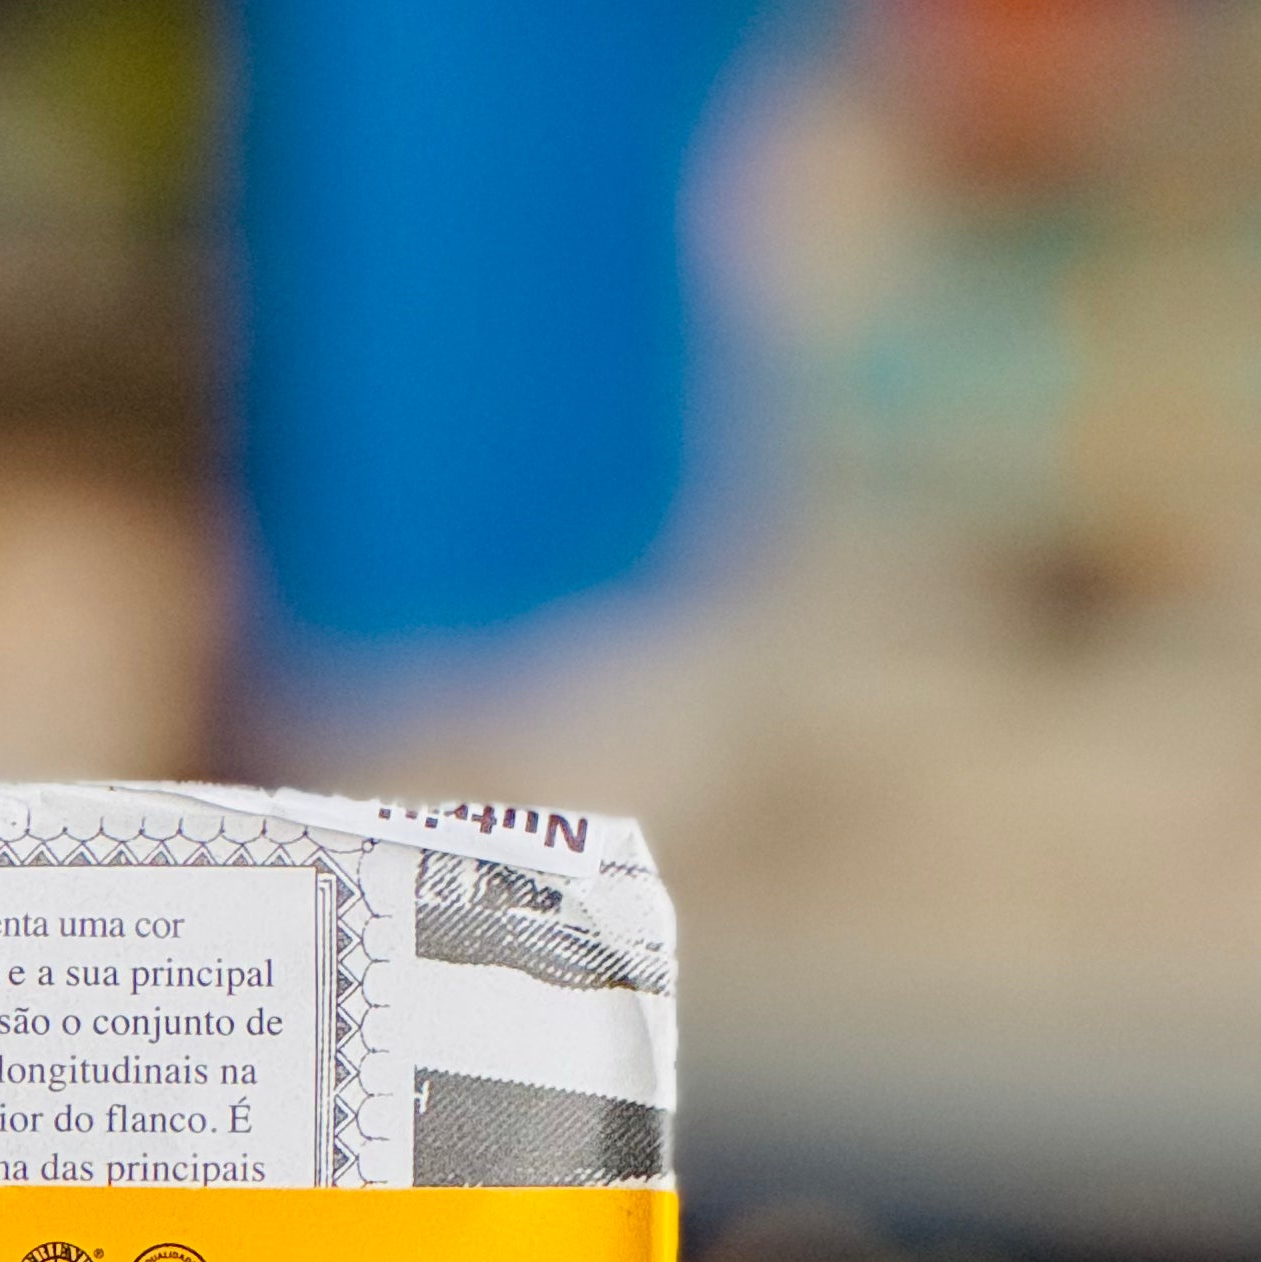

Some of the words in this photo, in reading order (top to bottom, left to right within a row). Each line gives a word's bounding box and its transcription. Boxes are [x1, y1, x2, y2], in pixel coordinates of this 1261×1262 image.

[58, 916, 127, 939] uma
[134, 916, 186, 940] cor
[7, 965, 26, 987] e
[37, 965, 56, 987] a
[65, 965, 121, 987] sua
[129, 957, 275, 997] principal
[61, 1014, 82, 1036] o
[92, 1005, 235, 1045] conjunto
[245, 1006, 284, 1037] de
[220, 1064, 259, 1086] na
[53, 1103, 95, 1134] do
[105, 1103, 218, 1135] flanco.
[227, 1095, 253, 1134] É
[40, 1152, 95, 1182] das
[107, 1151, 267, 1187] principais
